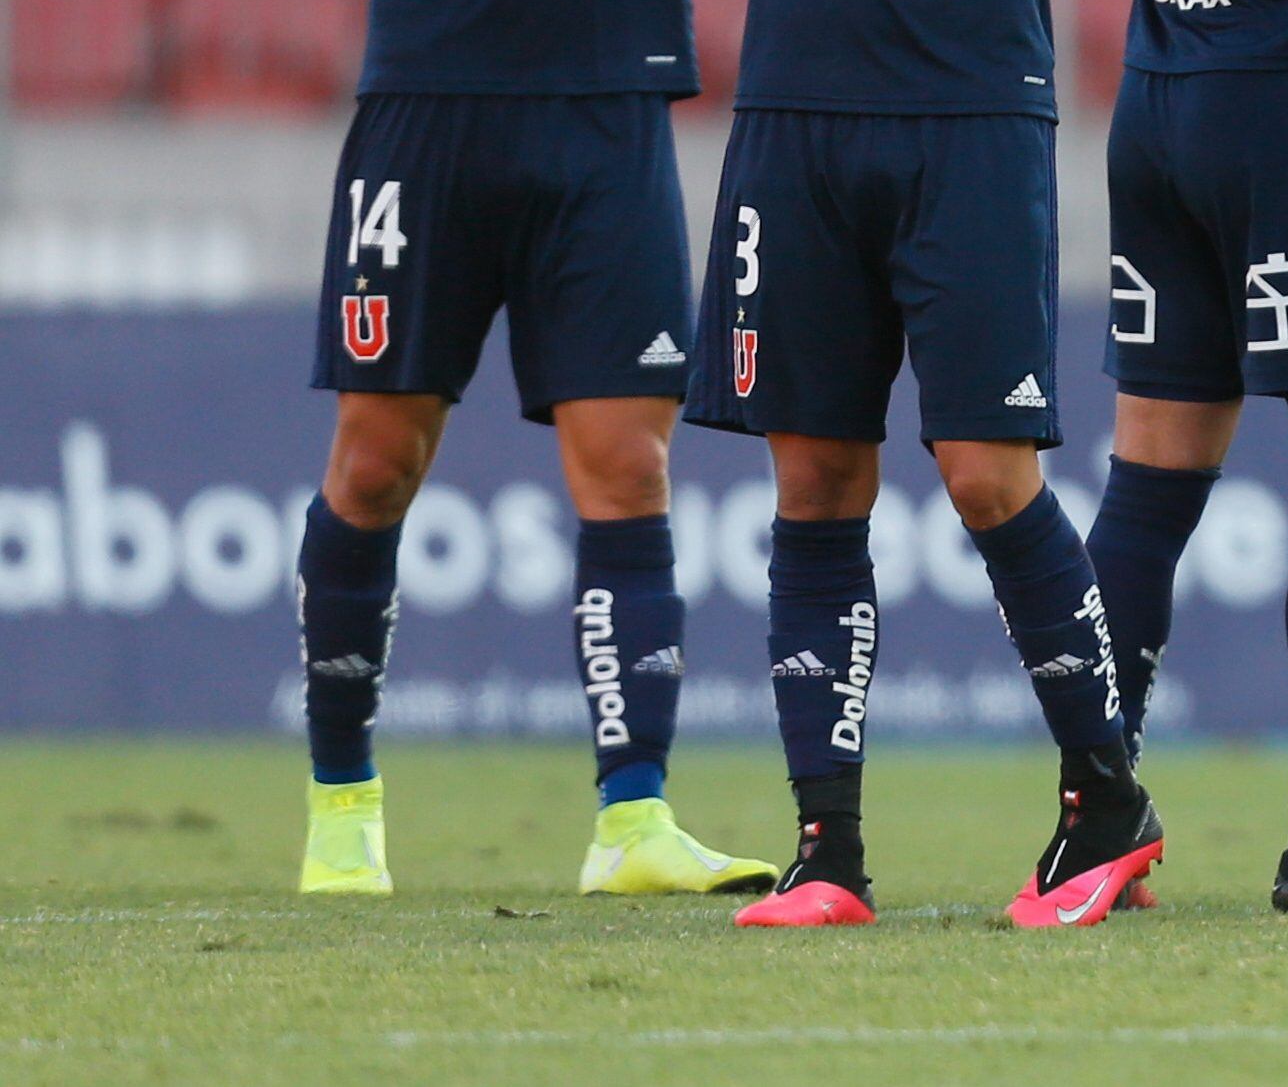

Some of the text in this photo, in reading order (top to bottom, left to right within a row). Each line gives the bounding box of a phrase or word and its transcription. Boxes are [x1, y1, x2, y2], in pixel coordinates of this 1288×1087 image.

[348, 178, 408, 269] 14
[735, 205, 761, 296] 3
[342, 295, 390, 362] U
[638, 351, 686, 364] adidas
[733, 327, 758, 398] U
[1004, 395, 1047, 408] adidas
[572, 587, 631, 747] Dolorub
[831, 601, 877, 753] Dolorub
